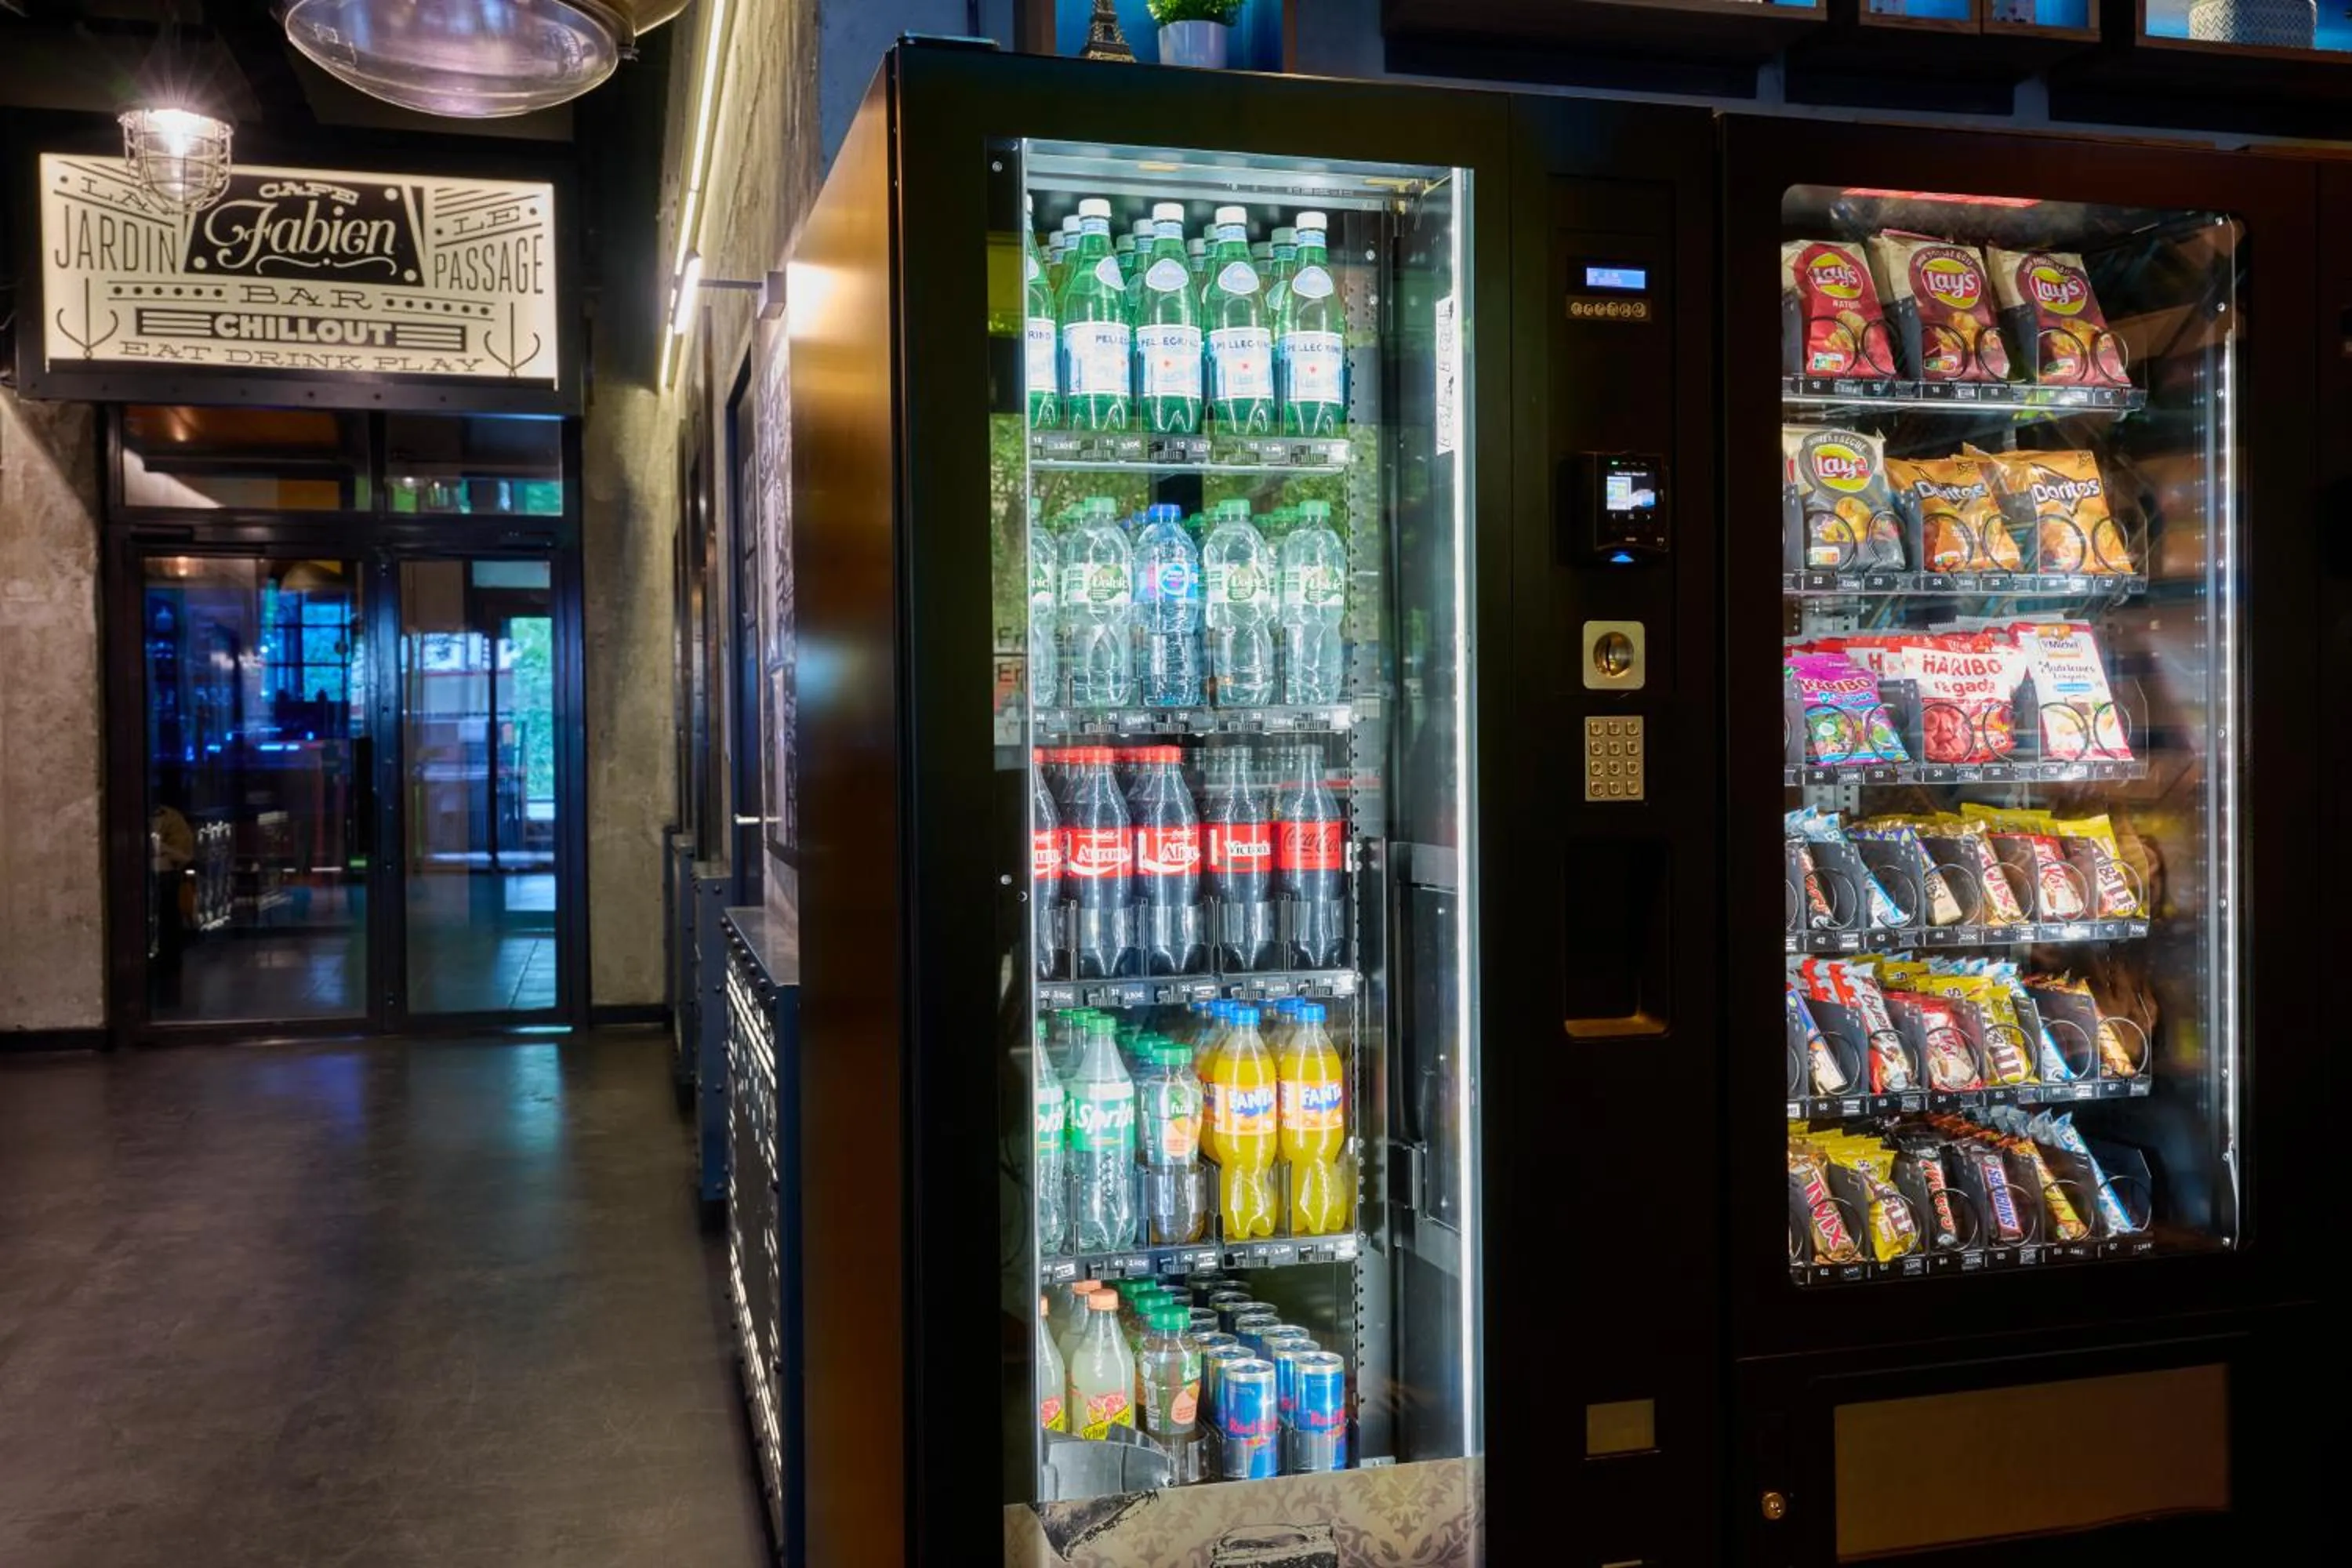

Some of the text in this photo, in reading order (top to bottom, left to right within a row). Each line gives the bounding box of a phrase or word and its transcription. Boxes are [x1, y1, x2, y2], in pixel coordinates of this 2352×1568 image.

[81, 176, 151, 213] LA
[259, 180, 361, 206] CAFE
[203, 199, 397, 265] Fabien
[453, 205, 521, 235] LE
[54, 205, 178, 274] JARDIN
[434, 235, 545, 295] PASSAGE
[240, 285, 373, 310] BAR
[1927, 270, 1976, 298] Lay's
[2035, 276, 2081, 305] Lay's
[212, 313, 393, 347] CHILLOUT
[119, 341, 485, 373] EAT DRINK PLAY
[2032, 478, 2100, 504] Doritos
[1922, 653, 2004, 677] HARIBO
[1799, 677, 1873, 691] HARIBO
[1987, 1167, 2016, 1229] SNICKRS
